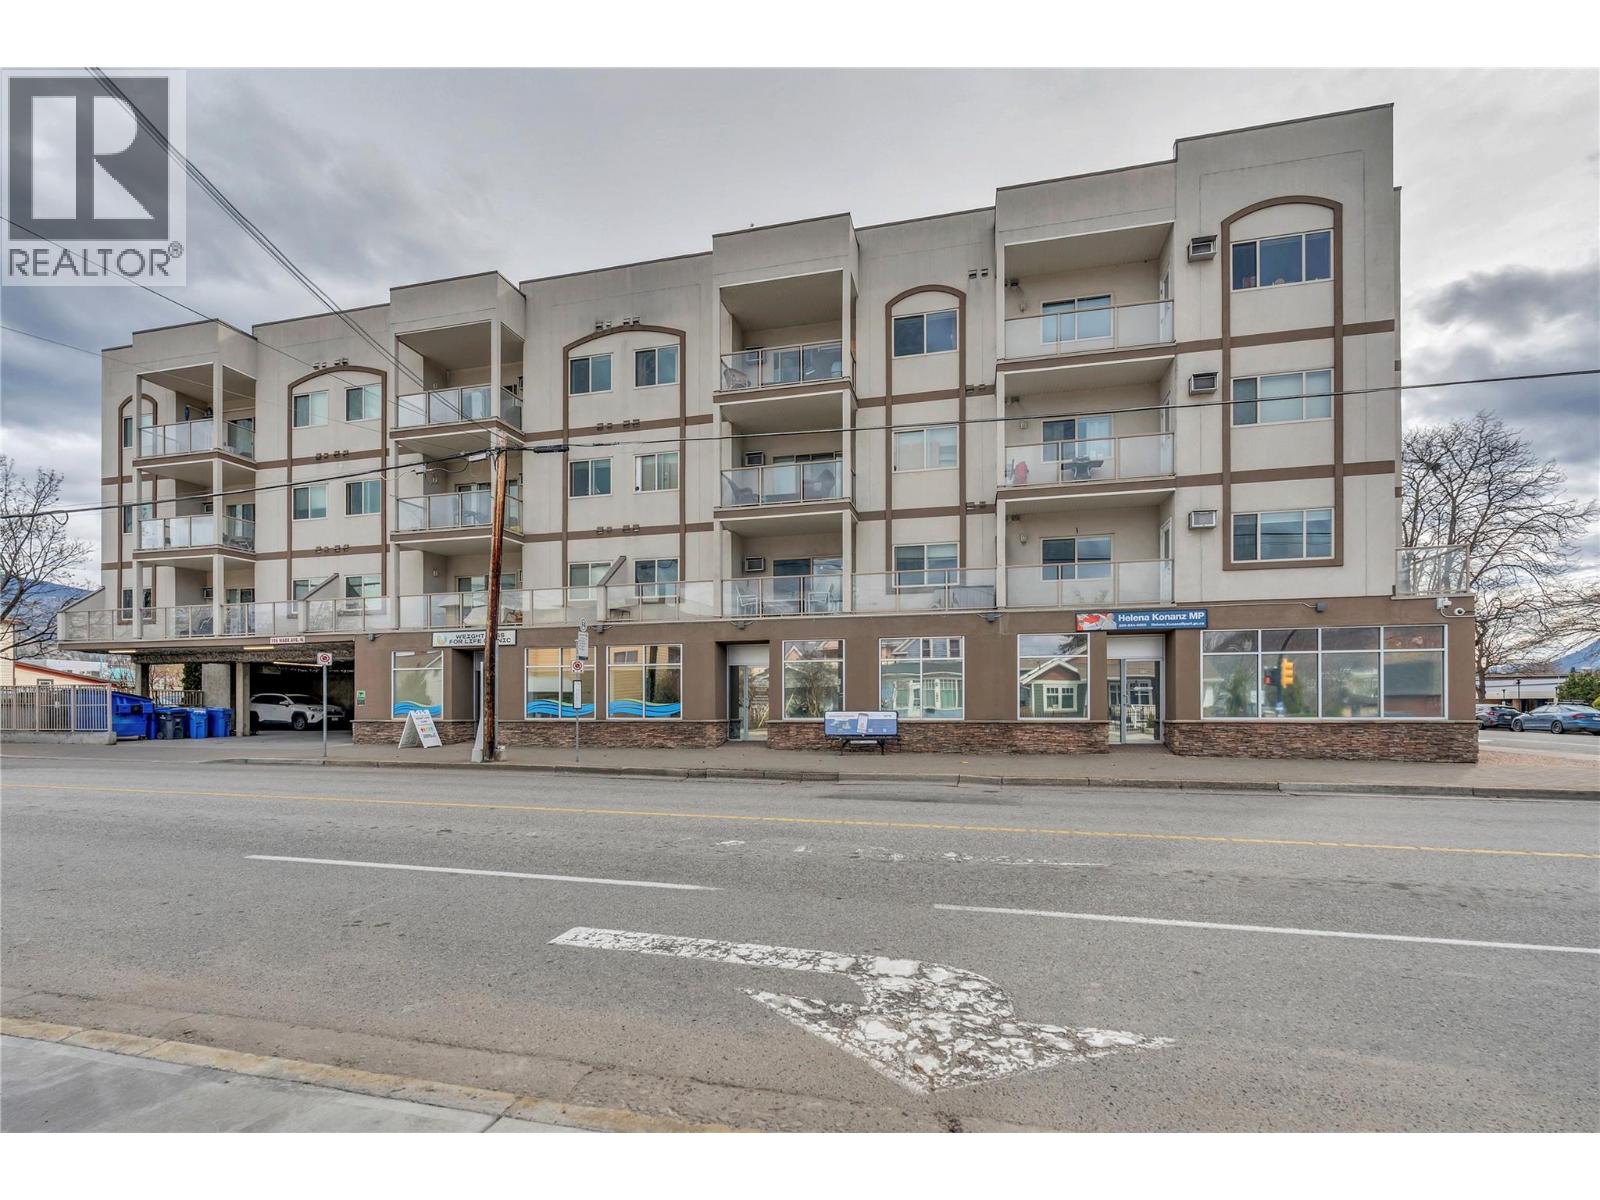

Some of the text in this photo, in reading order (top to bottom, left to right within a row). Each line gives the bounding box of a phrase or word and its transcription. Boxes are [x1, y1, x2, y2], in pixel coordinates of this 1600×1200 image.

[1118, 612, 1205, 622] Helena Konanz MP
